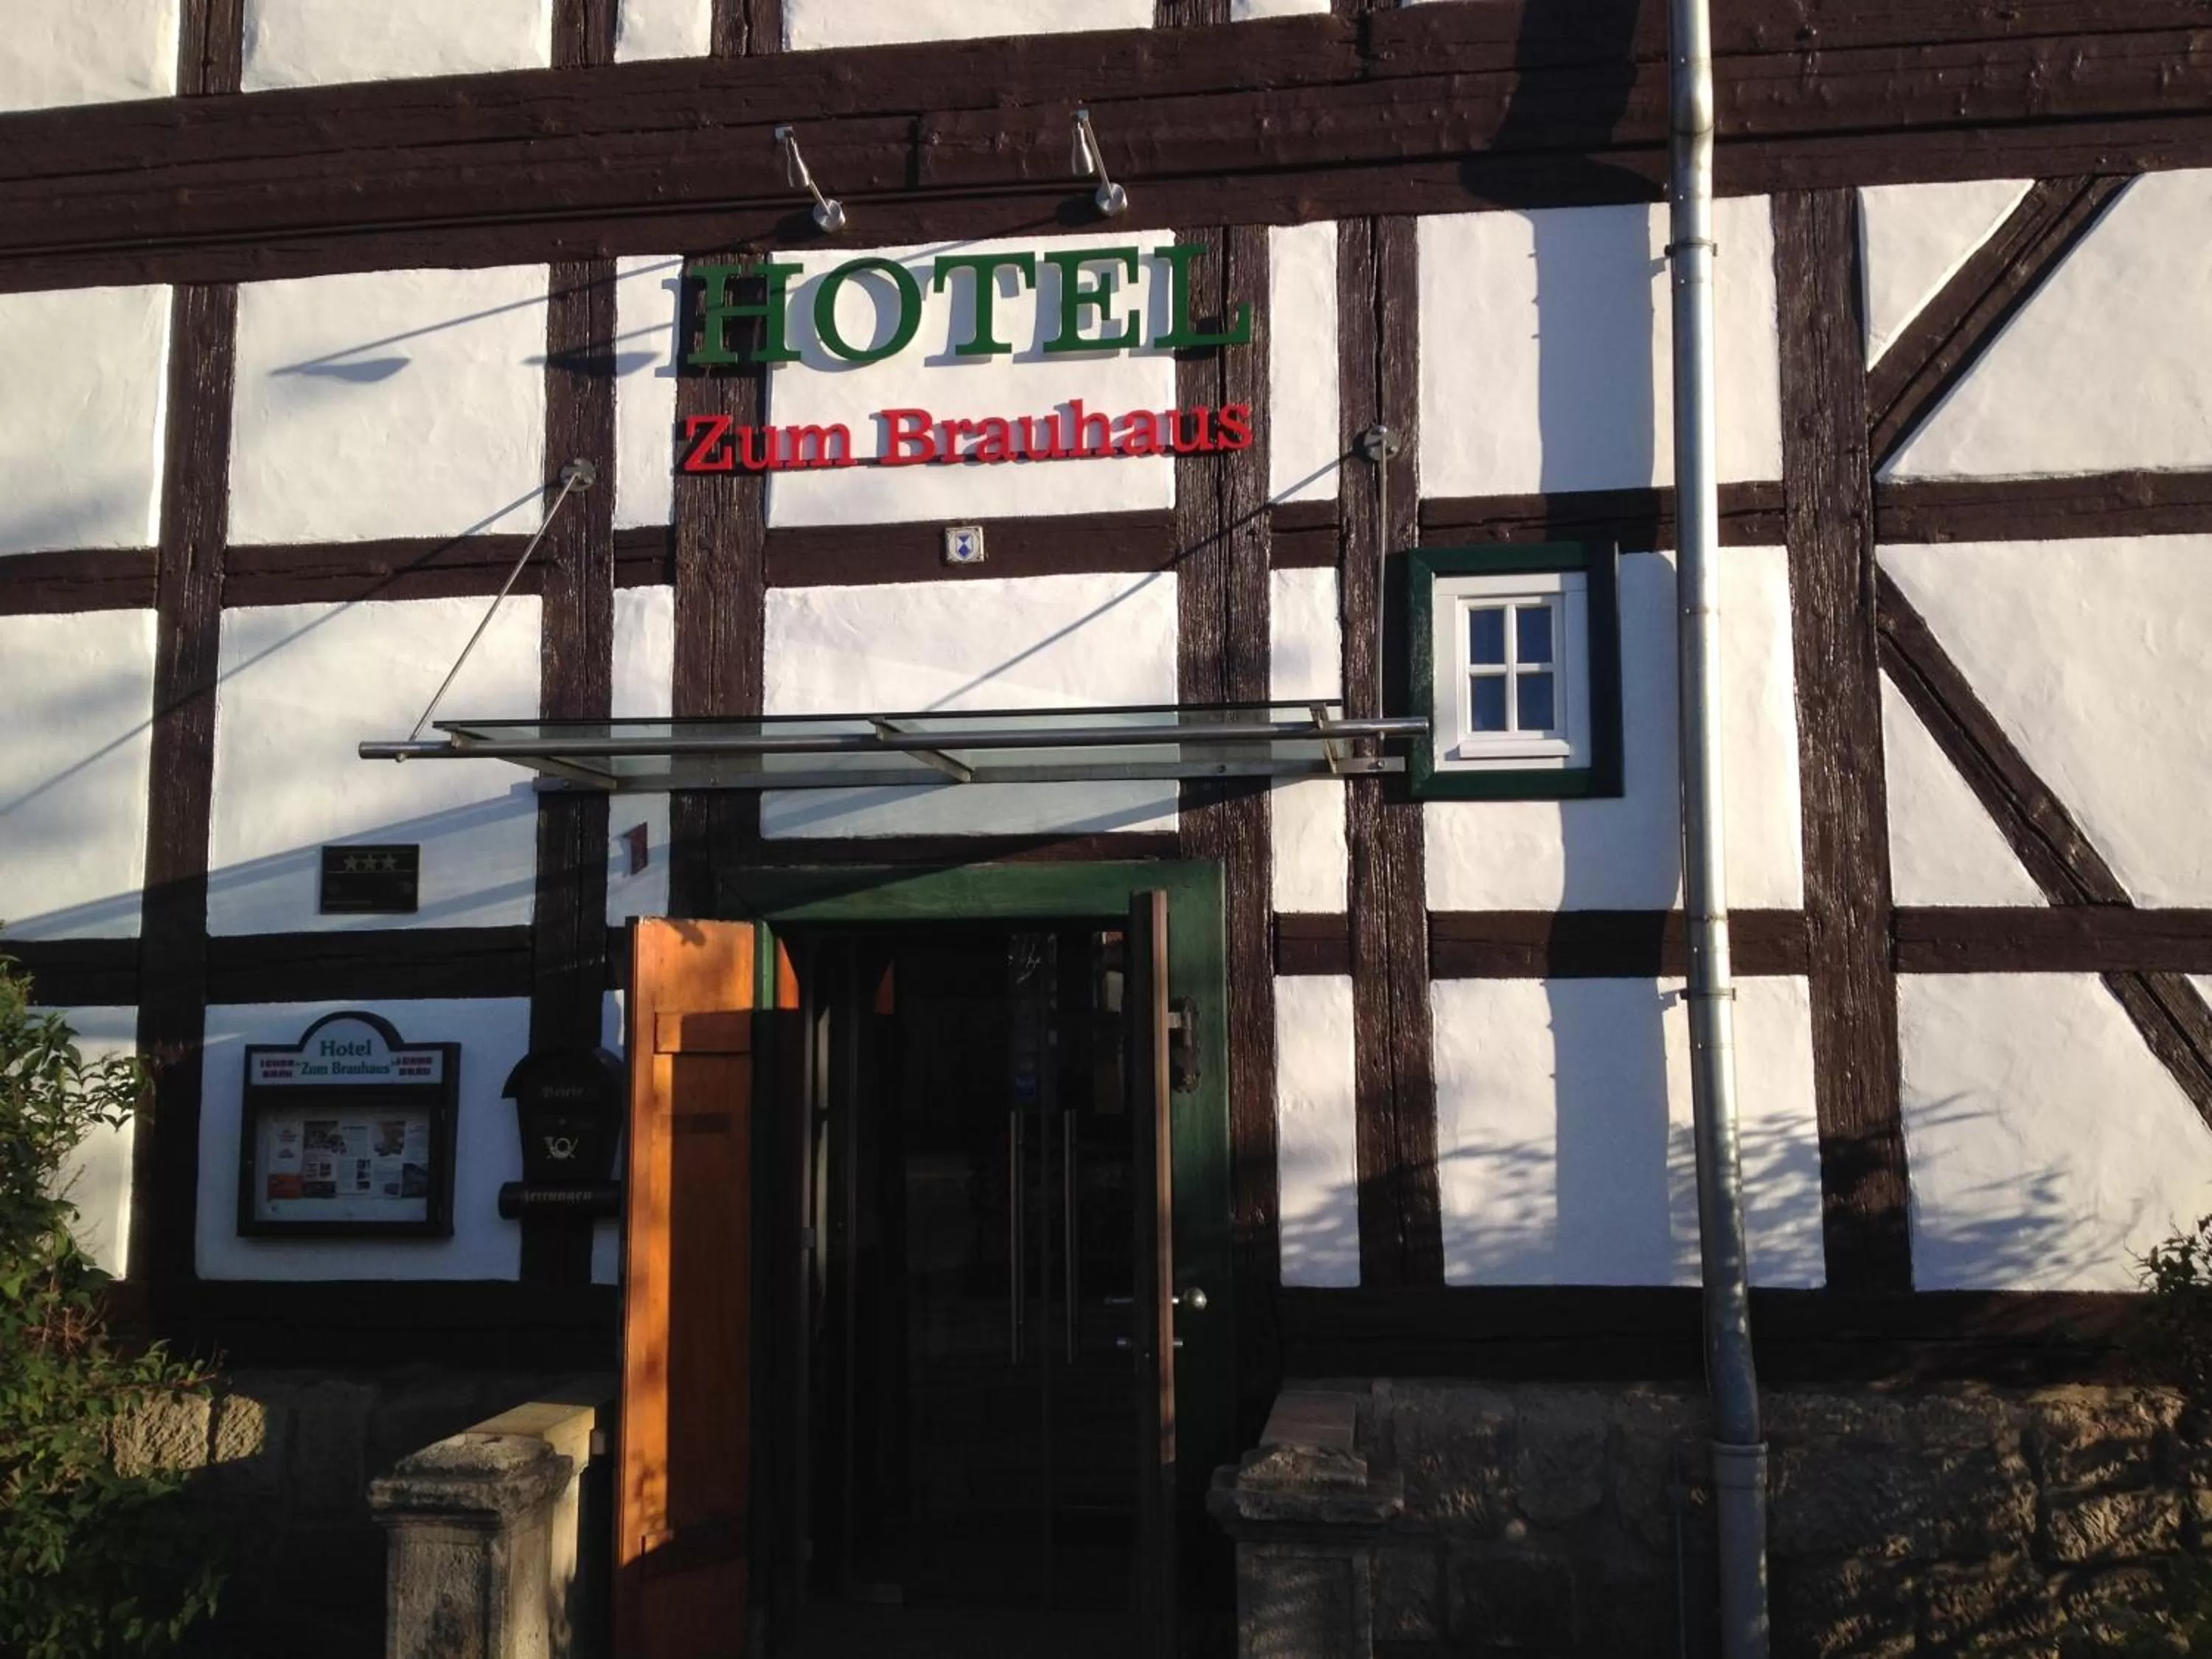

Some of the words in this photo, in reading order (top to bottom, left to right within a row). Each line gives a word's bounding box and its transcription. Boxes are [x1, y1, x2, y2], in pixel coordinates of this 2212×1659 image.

[687, 246, 1251, 366] HOTEL
[684, 414, 858, 471] Zum
[880, 398, 1253, 466] Brauhaus
[320, 1039, 372, 1057] Hotel
